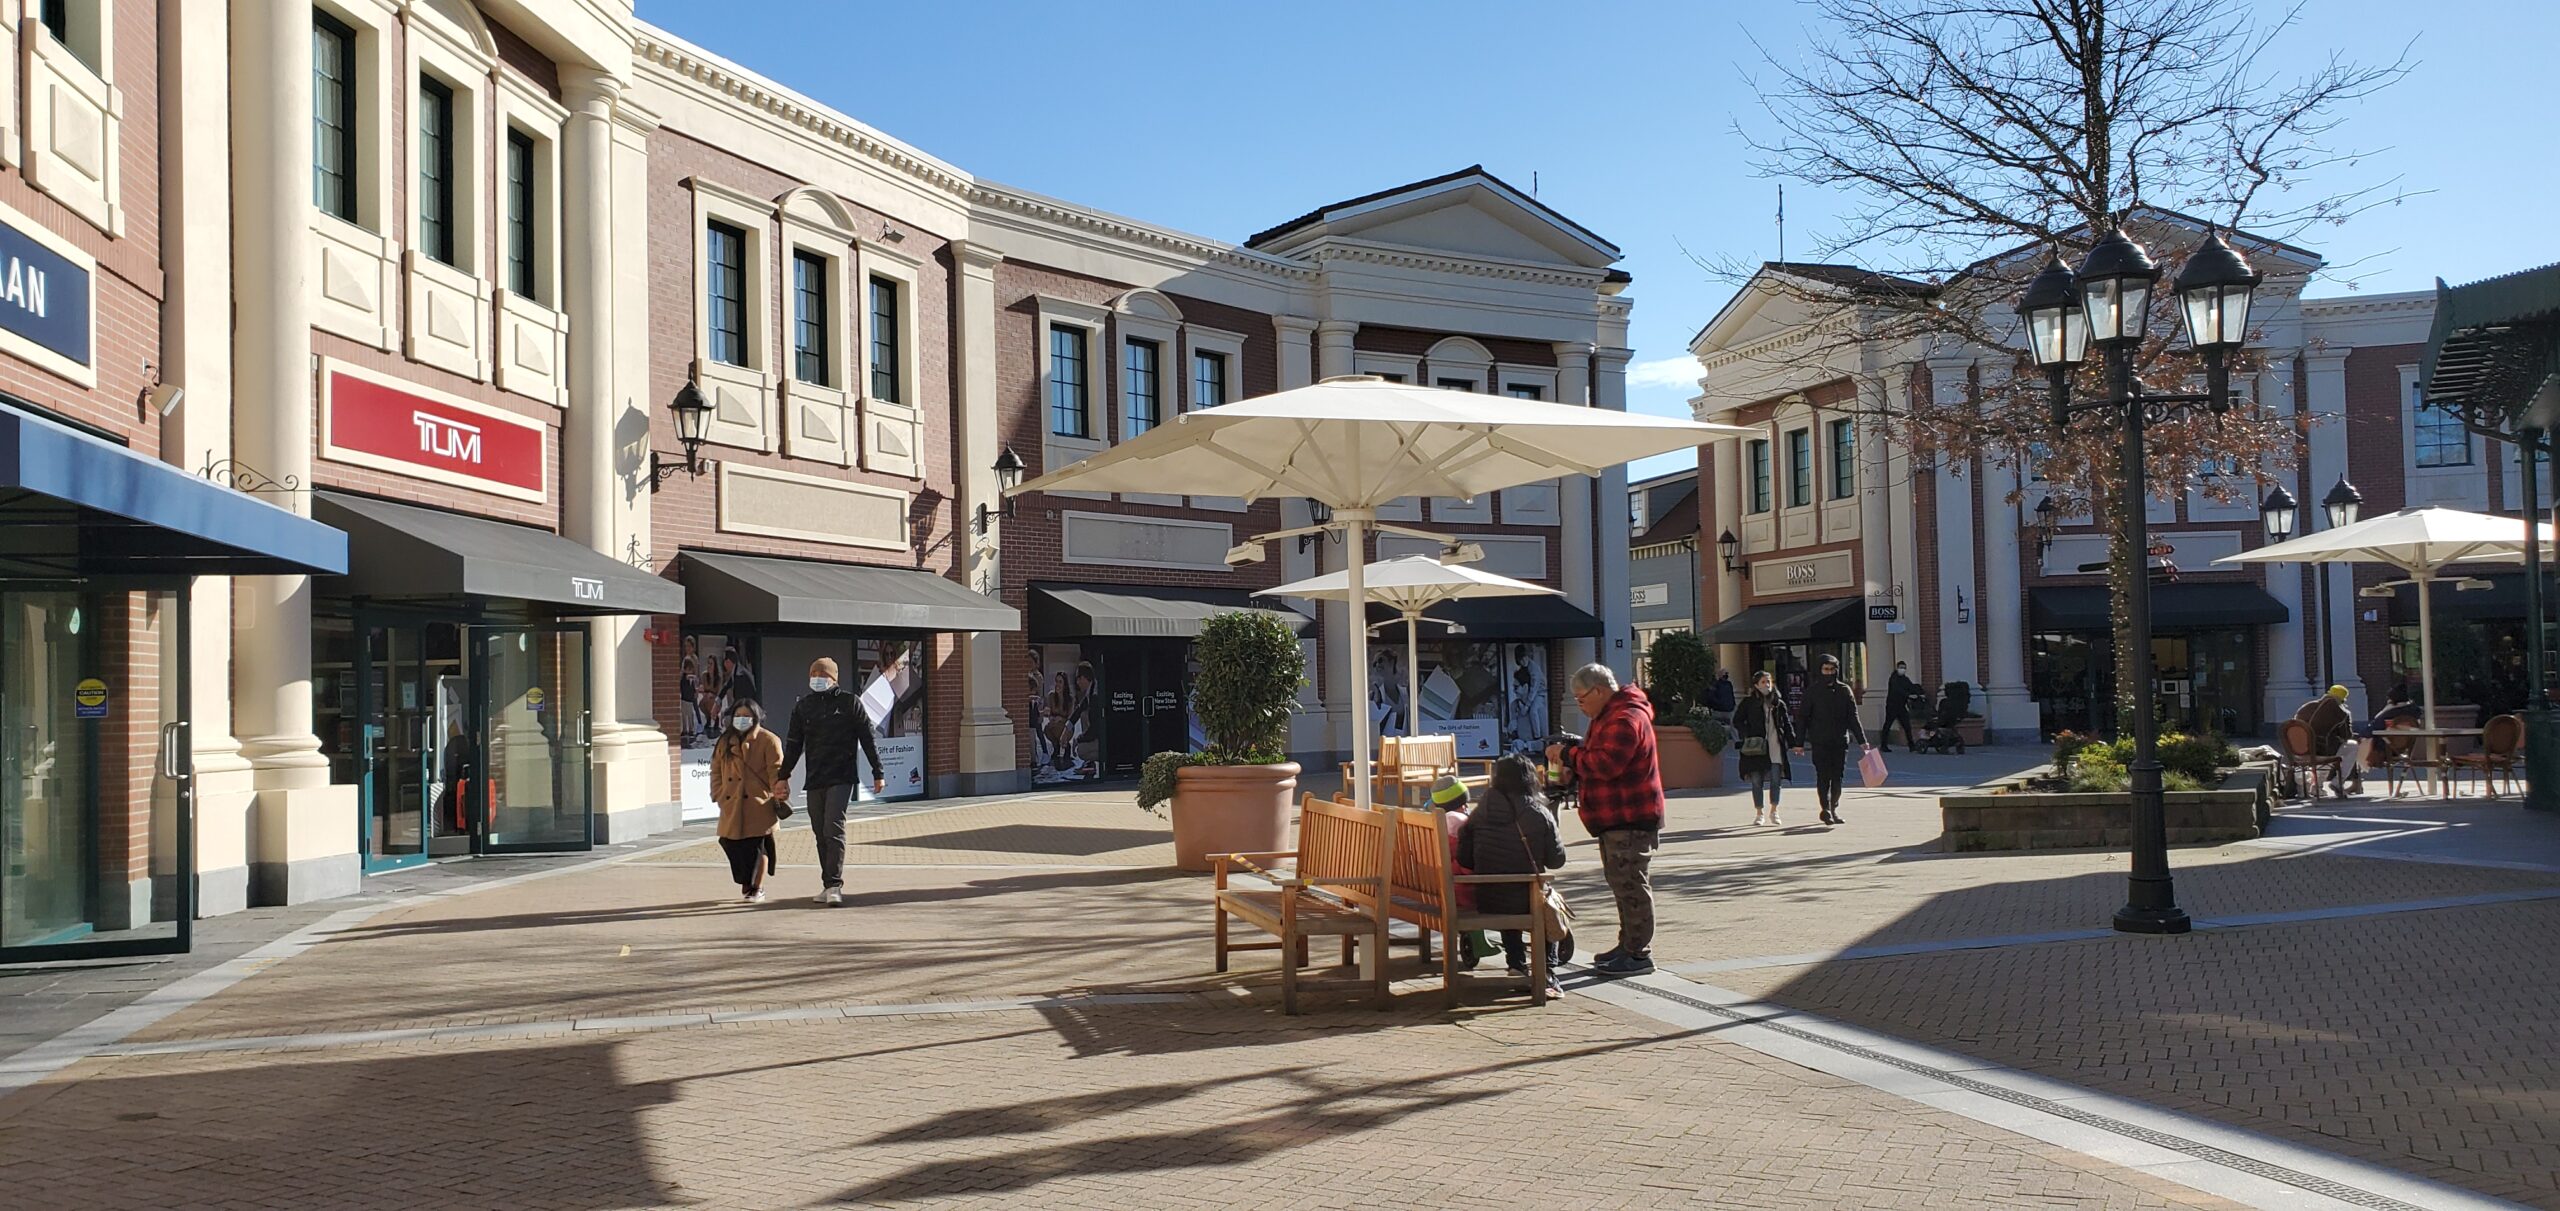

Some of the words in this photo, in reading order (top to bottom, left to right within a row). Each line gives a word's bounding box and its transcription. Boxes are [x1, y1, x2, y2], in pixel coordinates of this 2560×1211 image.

[0, 255, 45, 318] AN
[413, 410, 481, 464] TUMI
[1786, 563, 1815, 579] BOSS
[572, 577, 604, 600] TUMI
[1871, 607, 1895, 616] BOSS
[896, 744, 915, 753] Fashion
